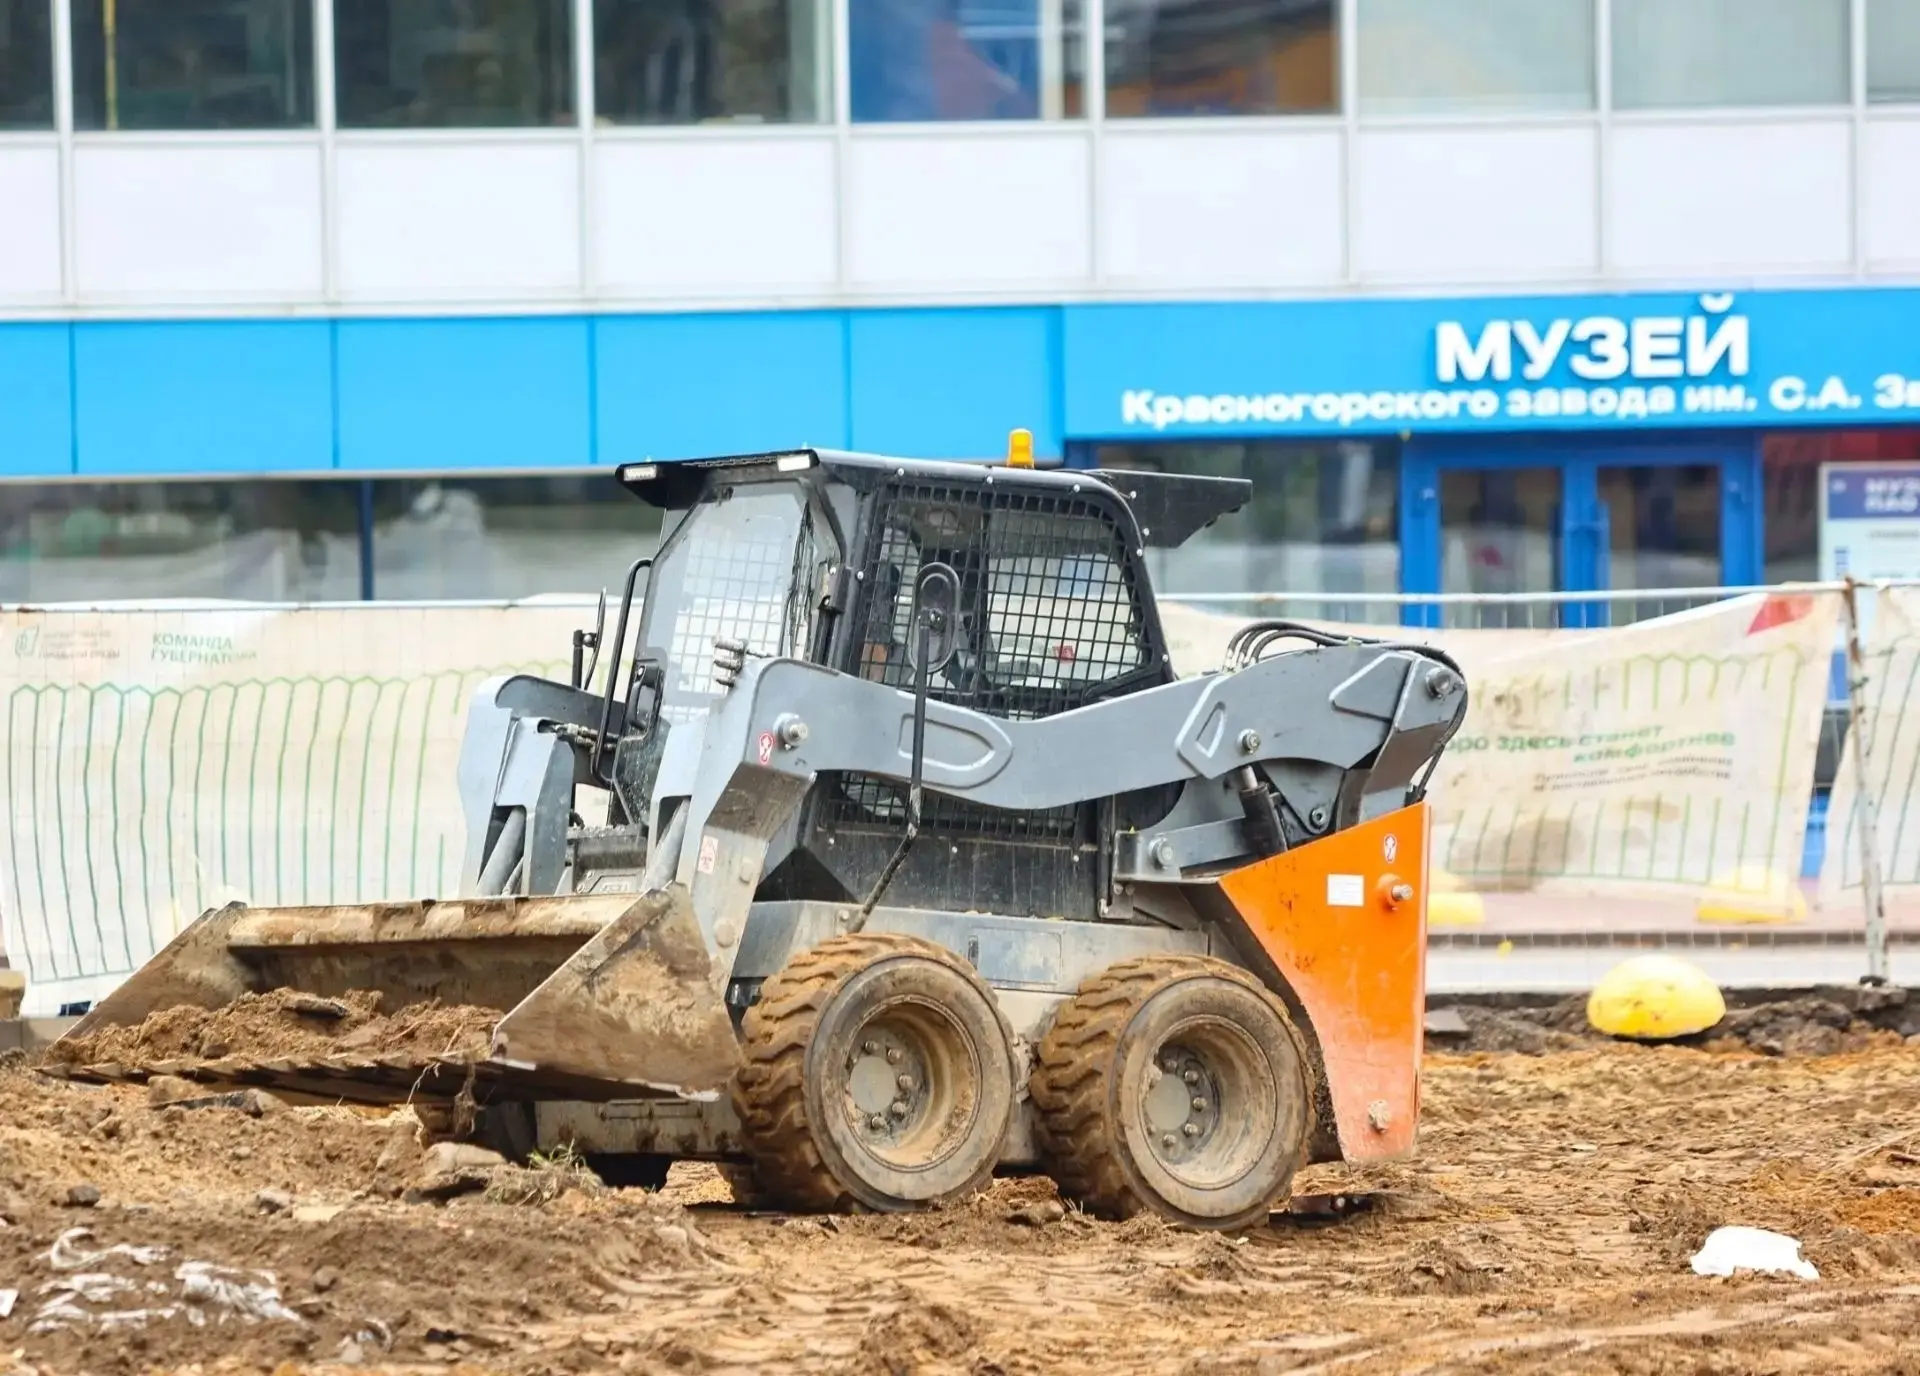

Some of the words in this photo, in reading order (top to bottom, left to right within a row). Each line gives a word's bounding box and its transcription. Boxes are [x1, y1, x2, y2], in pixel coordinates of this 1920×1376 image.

[1436, 293, 1750, 382] МУЗЕЙ
[1122, 389, 1499, 430] Красногорского
[1505, 384, 1676, 419] завода
[1683, 385, 1757, 414] им.
[1769, 376, 1861, 411] С.А.
[152, 632, 232, 650] КОМАНДА
